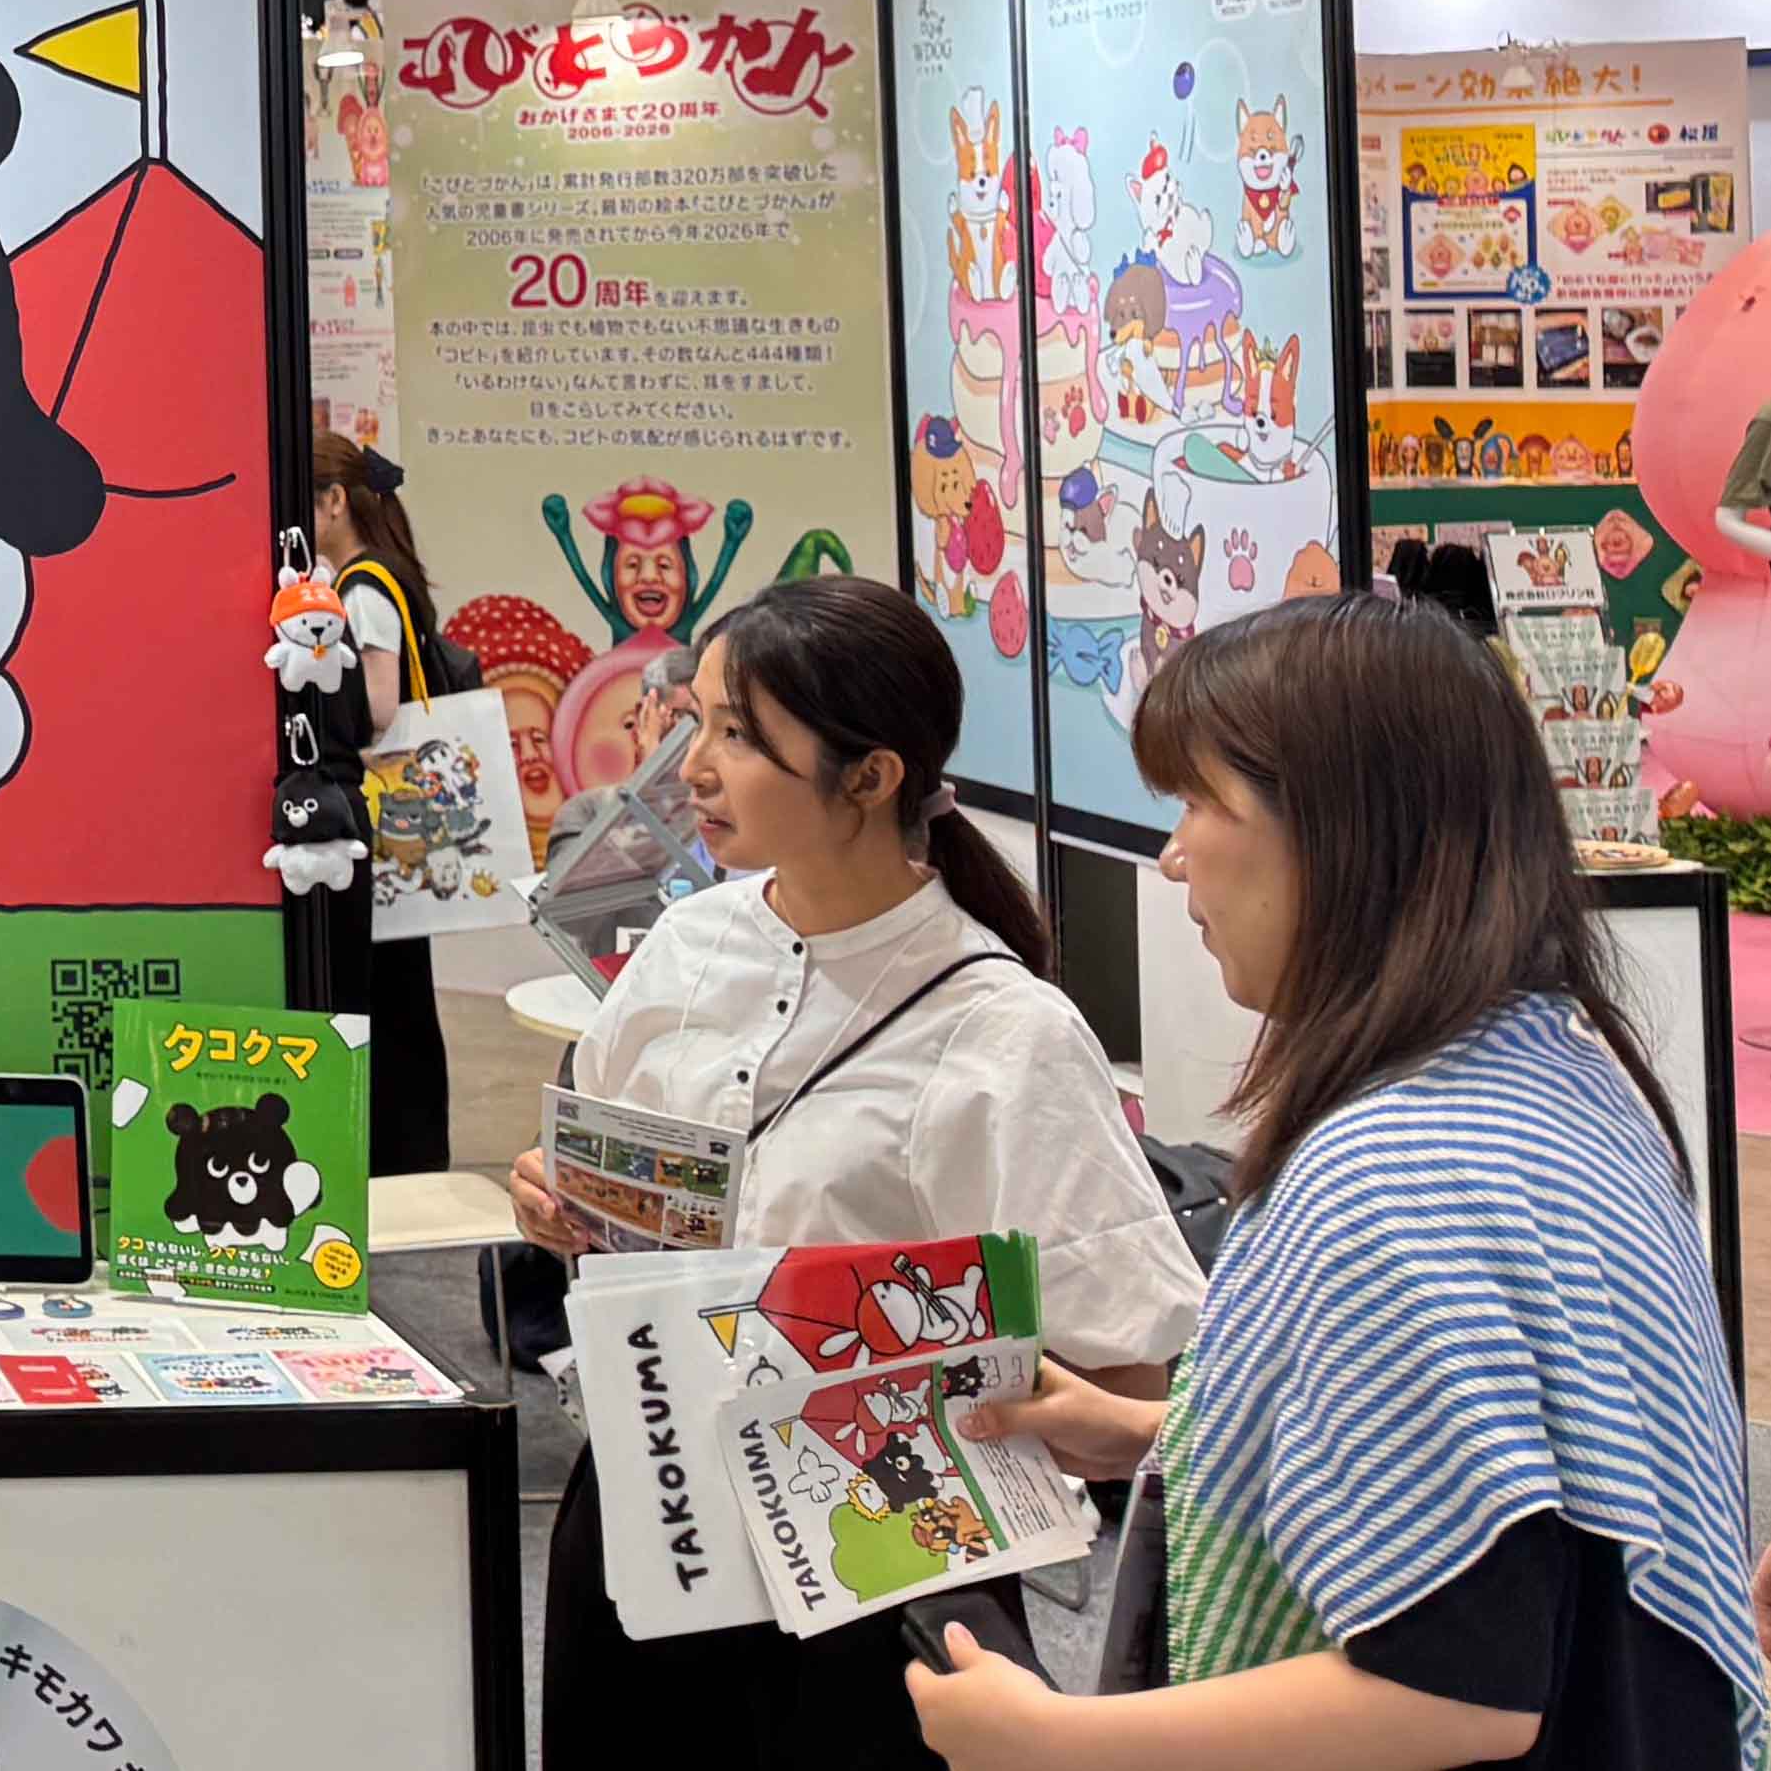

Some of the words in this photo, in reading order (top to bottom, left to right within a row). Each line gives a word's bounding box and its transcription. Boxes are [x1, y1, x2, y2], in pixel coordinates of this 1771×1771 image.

[163, 1020, 320, 1081] タコクマ
[627, 1322, 710, 1594] TAKOKUMA
[738, 1417, 828, 1614] TAKOKUMA
